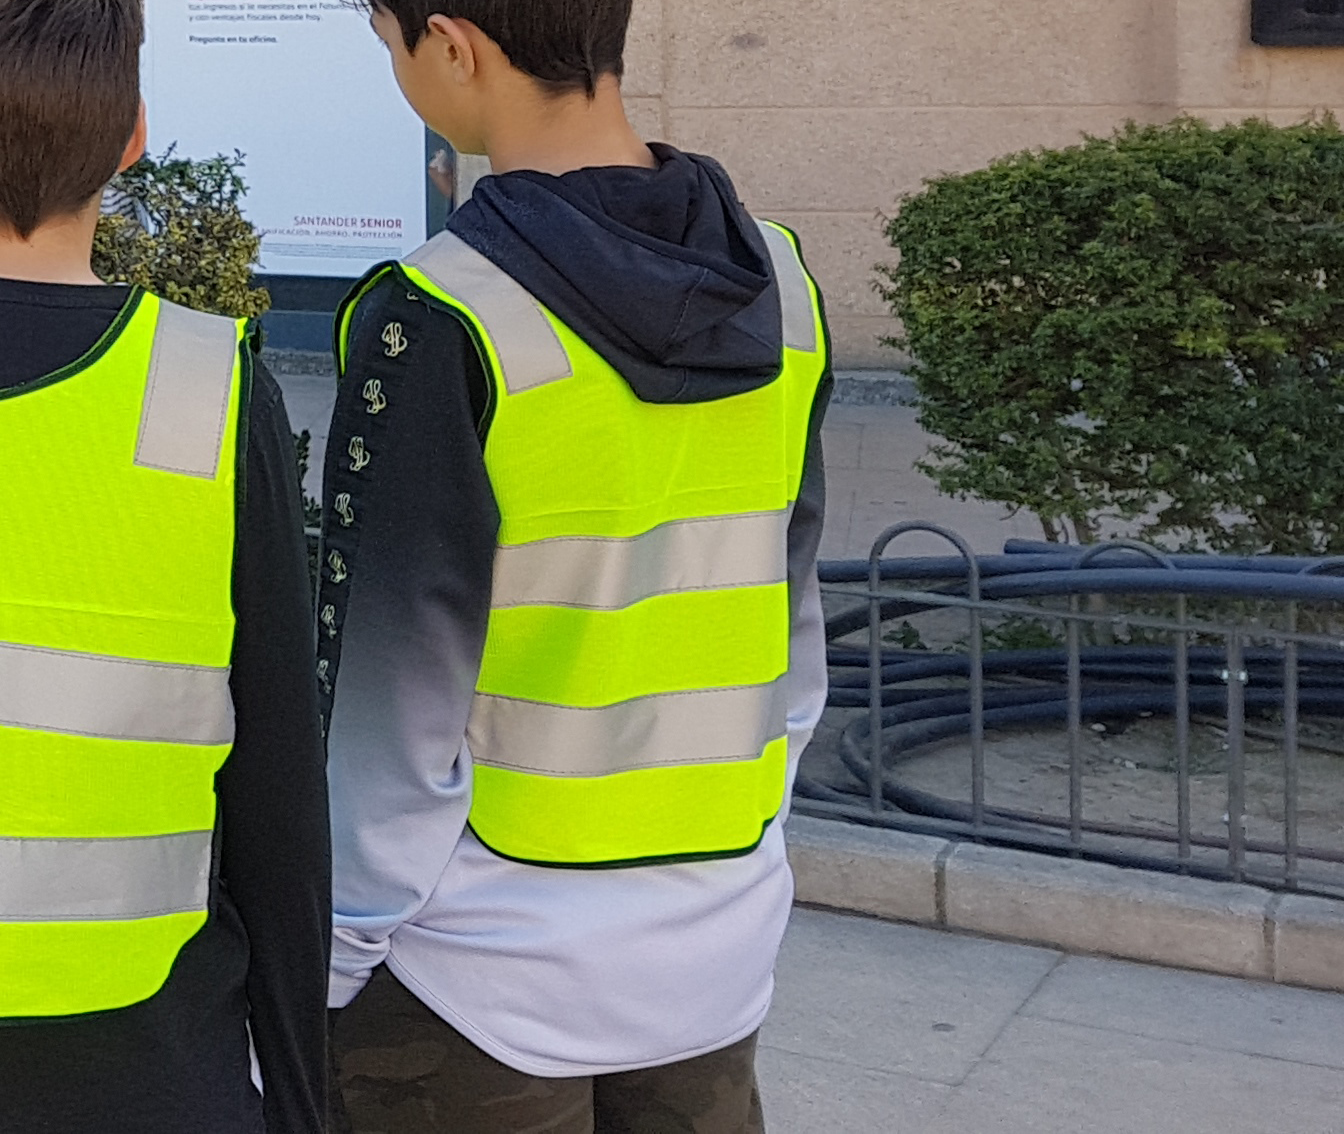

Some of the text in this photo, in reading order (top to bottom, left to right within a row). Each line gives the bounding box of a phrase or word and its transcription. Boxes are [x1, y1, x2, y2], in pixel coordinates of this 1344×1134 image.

[189, 36, 225, 44] Pregunta
[294, 216, 402, 229] SANTANDER SENIOR
